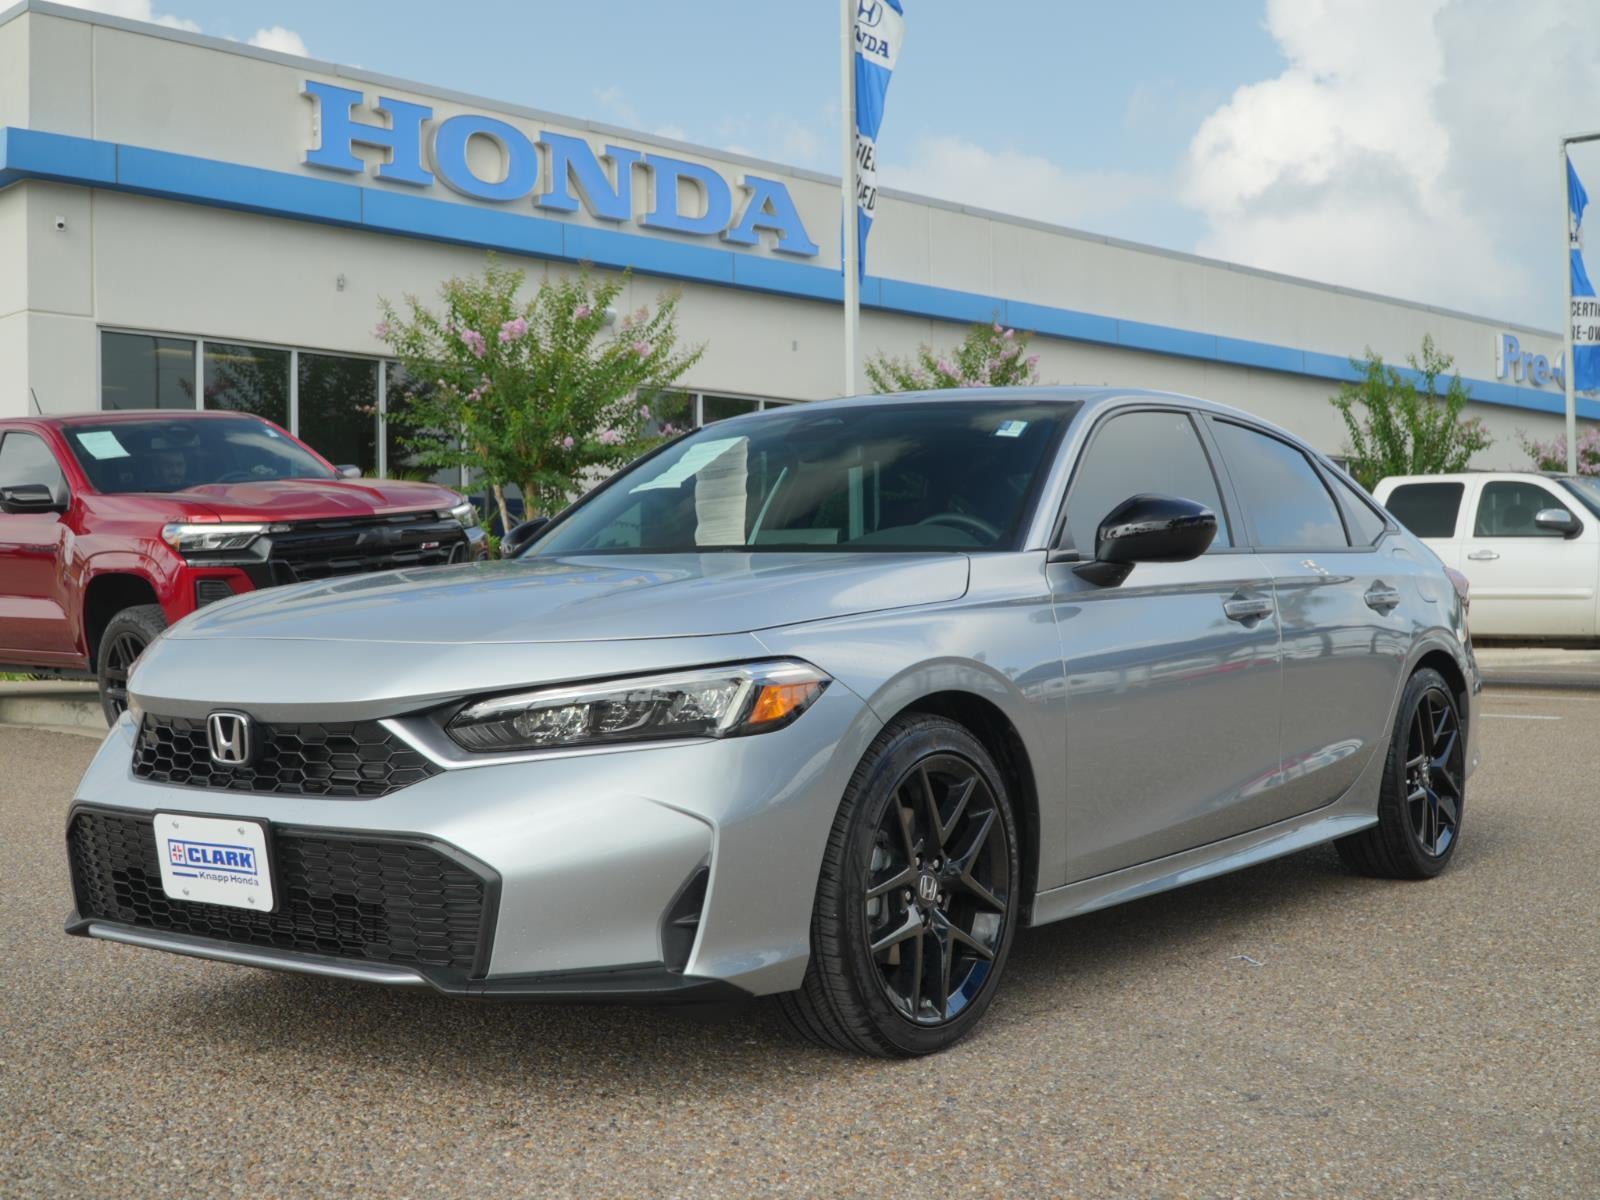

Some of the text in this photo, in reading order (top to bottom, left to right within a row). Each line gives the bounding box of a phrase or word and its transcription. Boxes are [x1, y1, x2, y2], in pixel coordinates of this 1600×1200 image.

[304, 79, 820, 257] HONDA
[1571, 301, 1600, 317] CERTI
[1496, 334, 1566, 391] Pre-
[187, 847, 252, 868] CLARK
[199, 871, 259, 886] Knapp Honda
